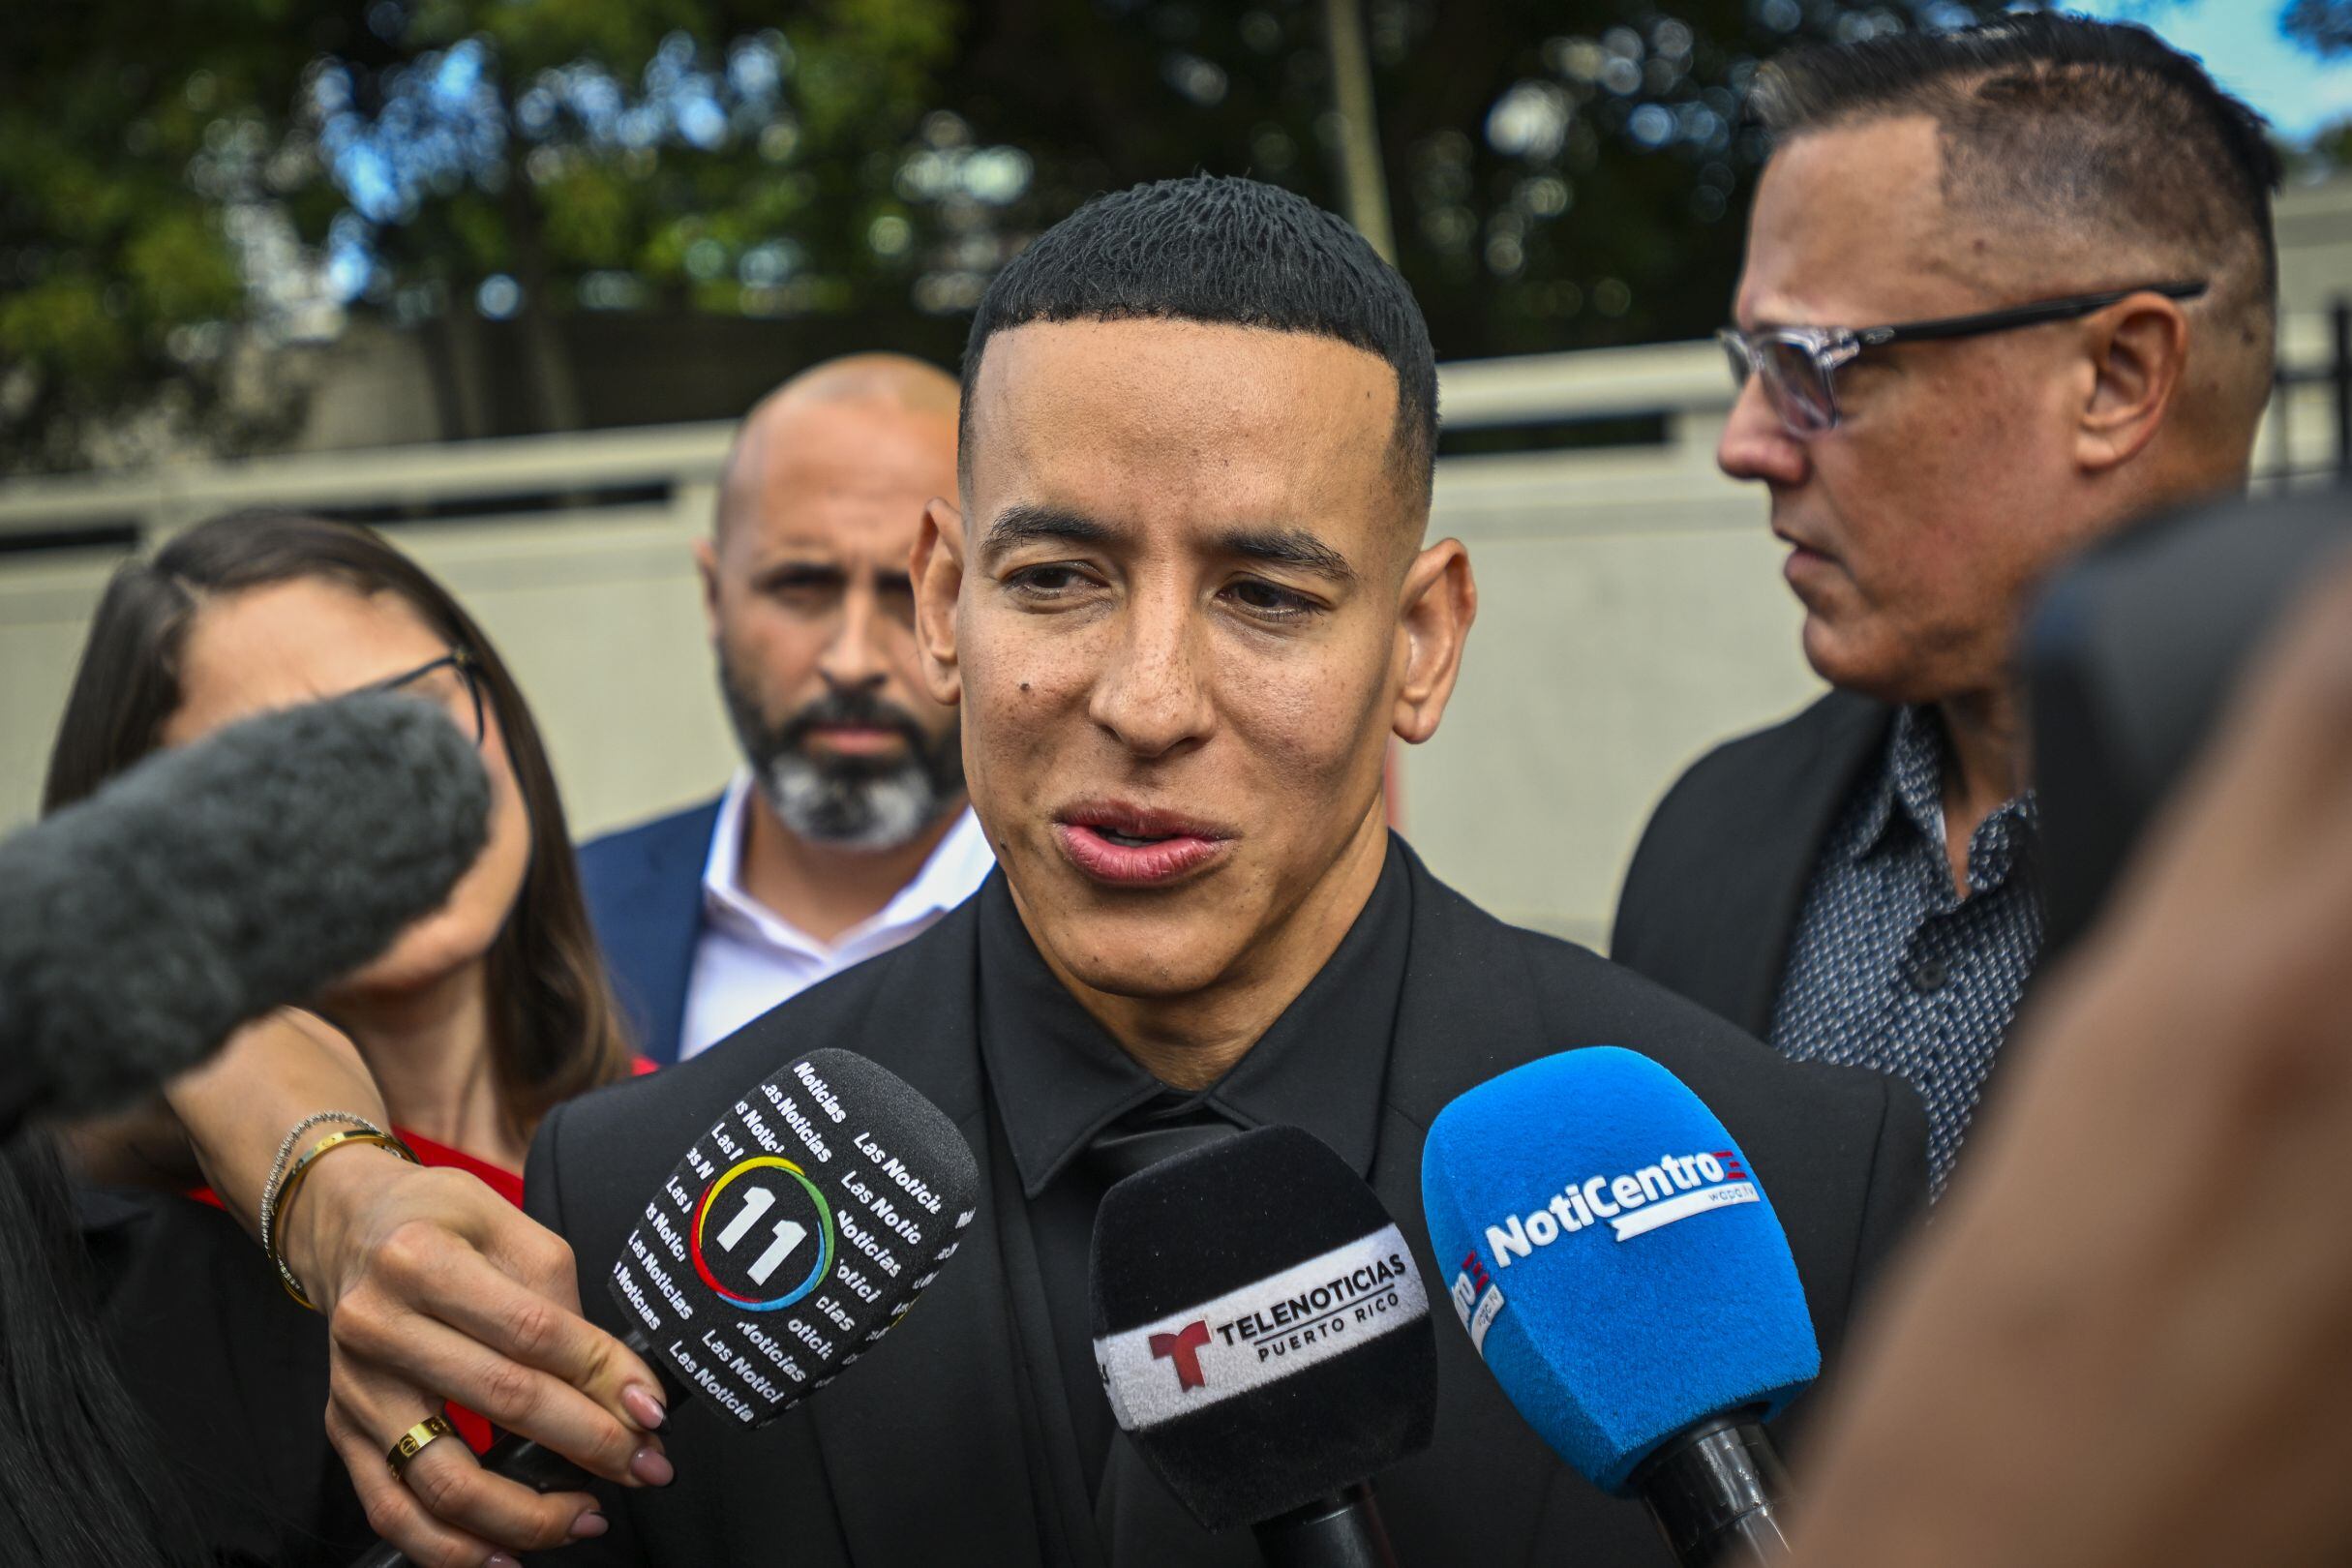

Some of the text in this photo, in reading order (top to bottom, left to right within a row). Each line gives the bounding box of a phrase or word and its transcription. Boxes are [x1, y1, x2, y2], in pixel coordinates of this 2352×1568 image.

[761, 1084, 832, 1162] as Noticias
[794, 1061, 847, 1123] Noticias
[711, 1122, 736, 1155] Las
[854, 1131, 886, 1163] Las
[666, 1175, 688, 1206] Las
[841, 1170, 873, 1204] Las
[870, 1196, 921, 1245] Notic
[1485, 1151, 1725, 1268] NotiCentro
[716, 1187, 808, 1286] 11
[616, 1266, 661, 1331] Noticias
[628, 1229, 693, 1320] Las Noticias
[1217, 1253, 1406, 1346] TELENOTICIAS
[669, 1340, 697, 1373] Las
[1258, 1292, 1400, 1363] PUERTO RICO
[702, 1329, 785, 1403] Las Notici
